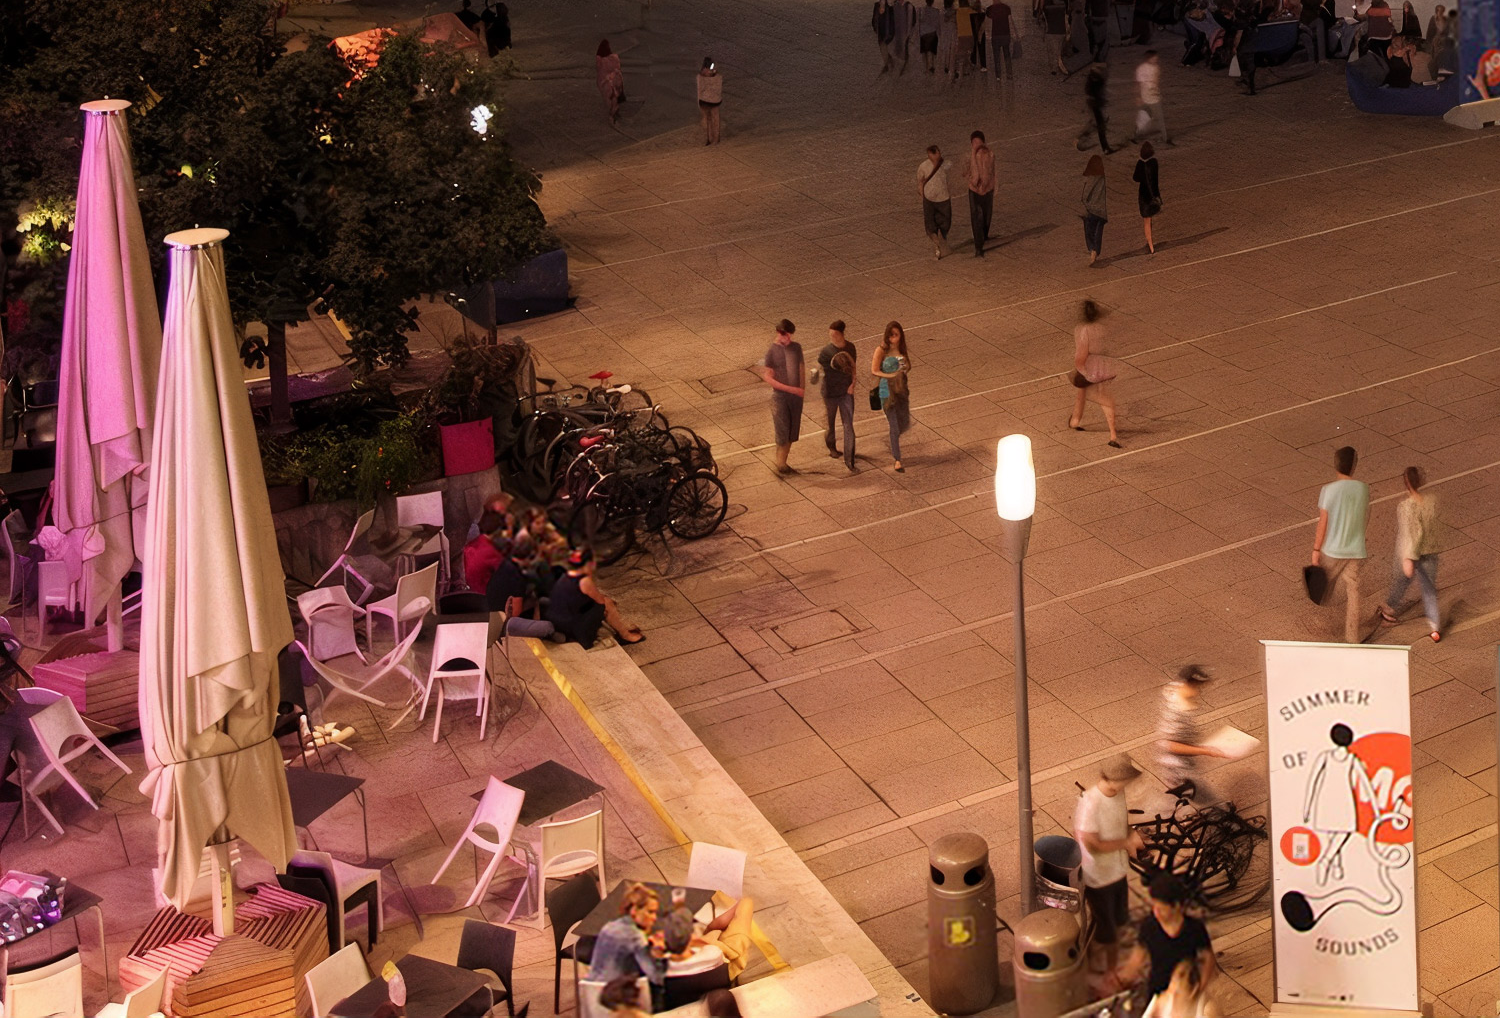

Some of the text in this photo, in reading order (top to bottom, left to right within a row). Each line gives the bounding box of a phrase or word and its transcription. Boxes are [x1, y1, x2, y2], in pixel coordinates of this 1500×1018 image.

[1280, 689, 1370, 722] SUMMER
[1282, 751, 1308, 769] OF
[1315, 927, 1399, 956] SOUNDS
